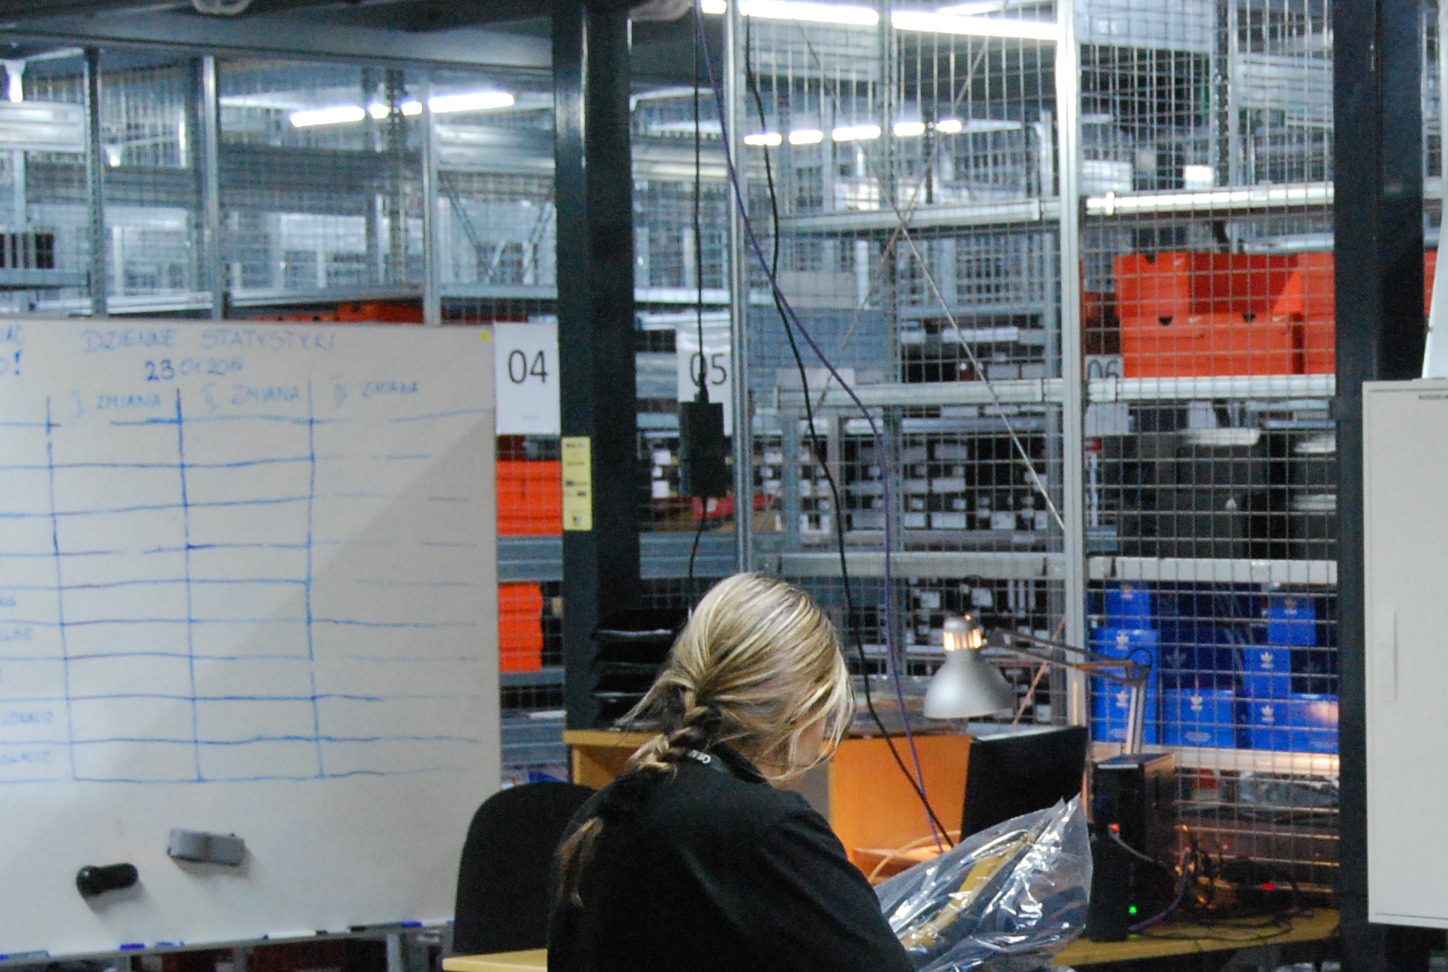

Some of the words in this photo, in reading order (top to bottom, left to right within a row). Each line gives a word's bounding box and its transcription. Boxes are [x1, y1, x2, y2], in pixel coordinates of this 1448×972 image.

[200, 328, 336, 351] STATYSTYKI
[508, 349, 548, 384] 04
[689, 352, 727, 386] 05
